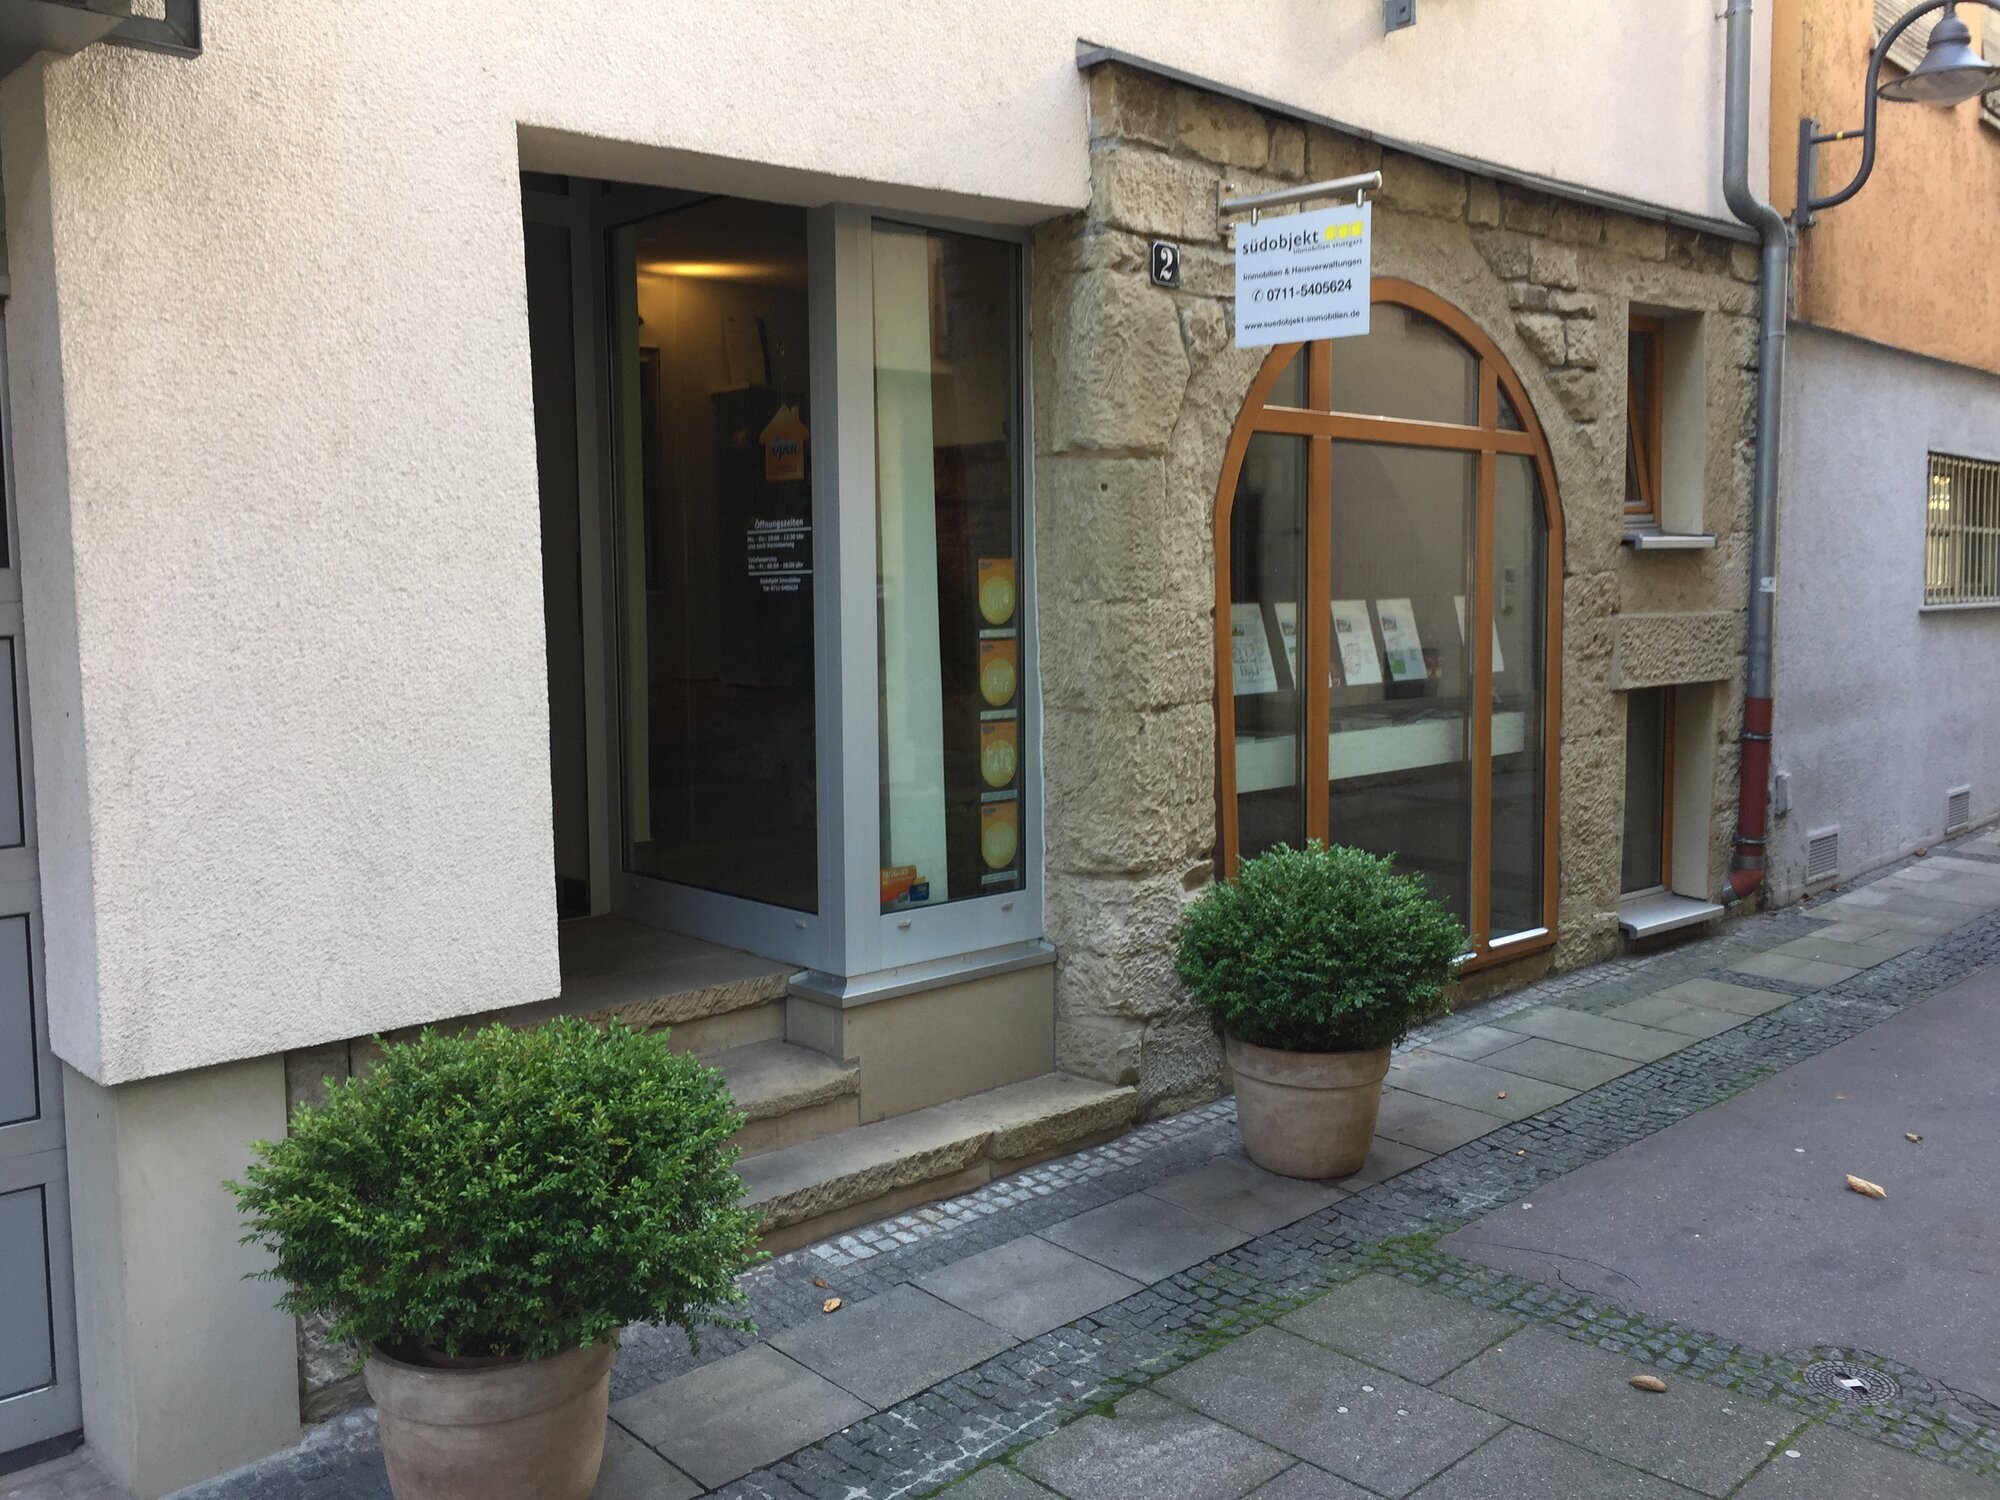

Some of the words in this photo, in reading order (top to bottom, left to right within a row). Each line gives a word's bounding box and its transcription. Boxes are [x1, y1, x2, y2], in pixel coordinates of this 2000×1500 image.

[1242, 229, 1319, 255] südobjekt
[1160, 247, 1173, 281] 2
[1243, 269, 1283, 281] Immobilien
[1284, 267, 1290, 275] &
[1291, 258, 1362, 274] Hausverwaltungen
[1266, 278, 1352, 302] 0711-5405624
[1244, 309, 1361, 331] www.suedobjekt-immobilien.de
[754, 517, 804, 530] Öffnungszeiten
